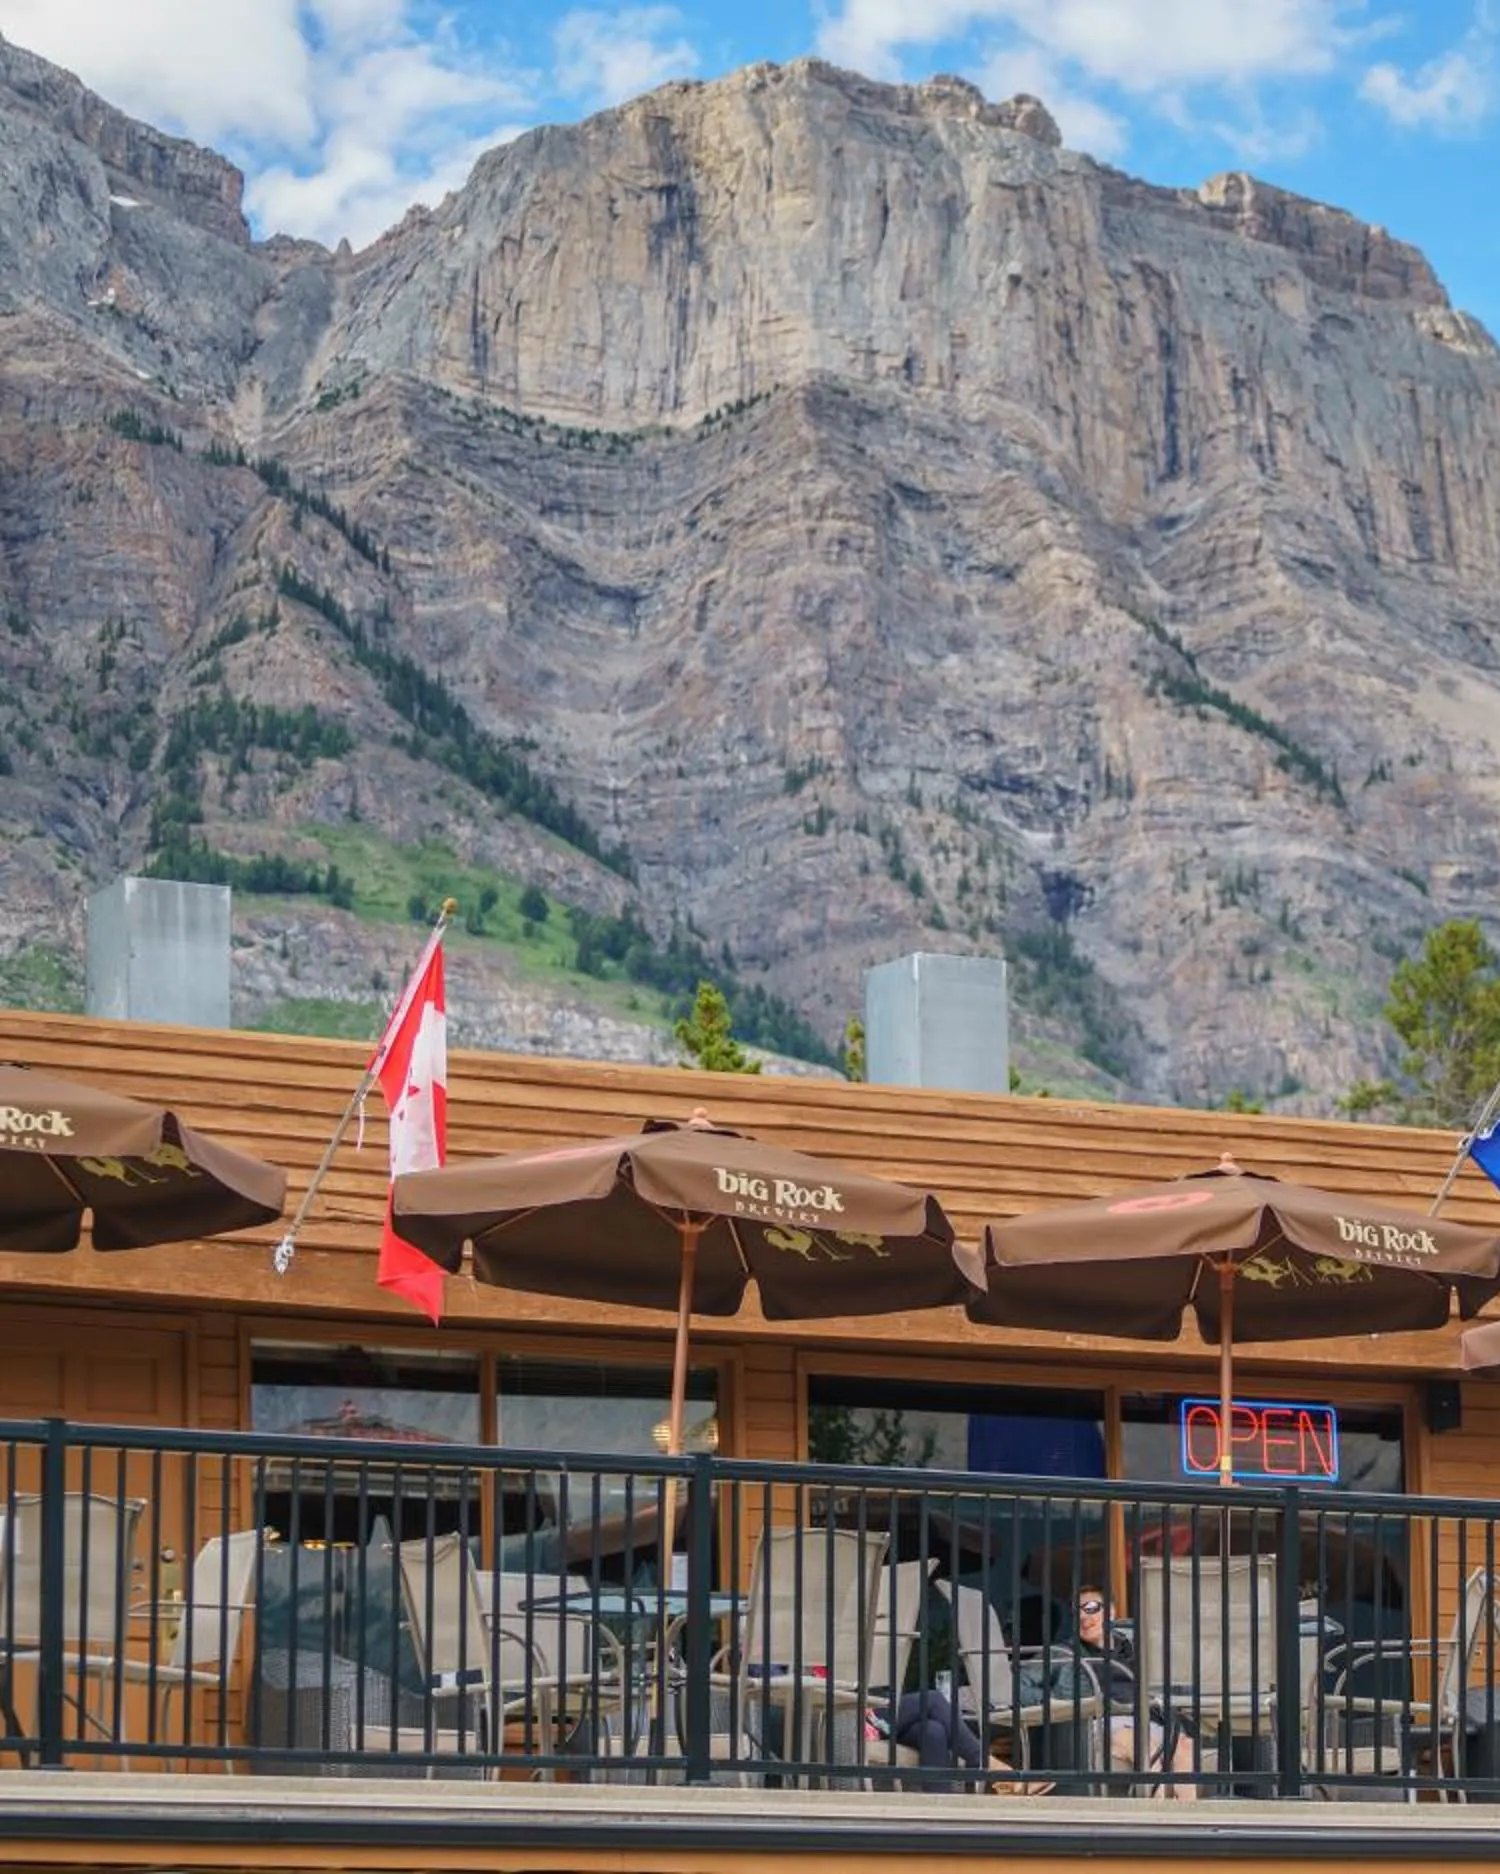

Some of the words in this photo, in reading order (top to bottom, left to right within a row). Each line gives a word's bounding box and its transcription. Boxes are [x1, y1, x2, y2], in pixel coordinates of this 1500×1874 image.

[0, 1106, 75, 1137] Rock
[772, 1179, 845, 1213] Rock
[1381, 1225, 1439, 1254] Rock
[1187, 1406, 1333, 1476] OPEN
